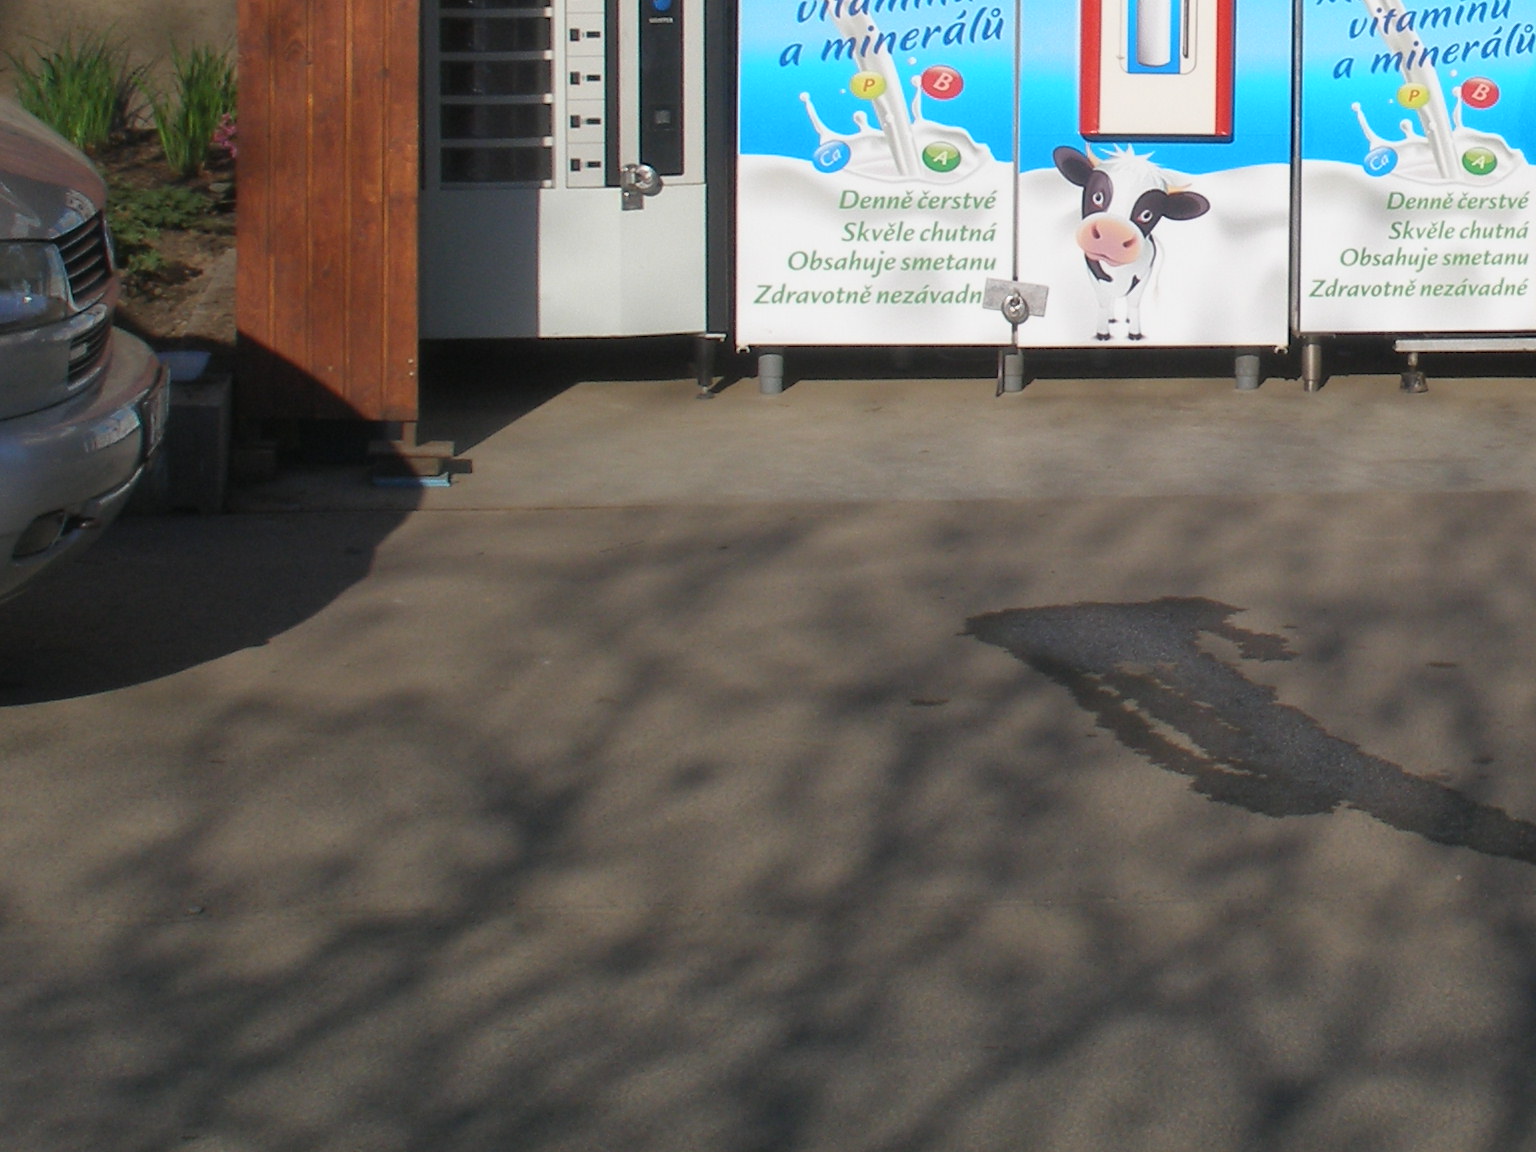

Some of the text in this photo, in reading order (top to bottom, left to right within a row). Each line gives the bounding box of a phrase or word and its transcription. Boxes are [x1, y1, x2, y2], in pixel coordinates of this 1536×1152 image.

[779, 7, 1004, 67] a minerálů
[1333, 23, 1536, 80] a minerálů
[863, 78, 876, 92] P
[933, 72, 953, 91] B
[1408, 88, 1420, 102] P
[1472, 84, 1490, 102] B
[820, 147, 842, 166] Ca
[934, 150, 949, 166] A
[1369, 154, 1390, 170] Ca
[1472, 155, 1486, 169] A
[838, 189, 998, 210] Denně čerstvé
[1386, 190, 1530, 210] Denně čerstvé
[841, 221, 998, 242] Skvěle chutná
[1388, 221, 1529, 240] Skvěle chutná
[787, 250, 997, 278] Obsahuje smetanu
[1340, 247, 1529, 272] Obsahuje smetanu
[753, 284, 984, 305] Zdravotně nezávadn
[1309, 278, 1529, 297] Zdravotně nezávadné
